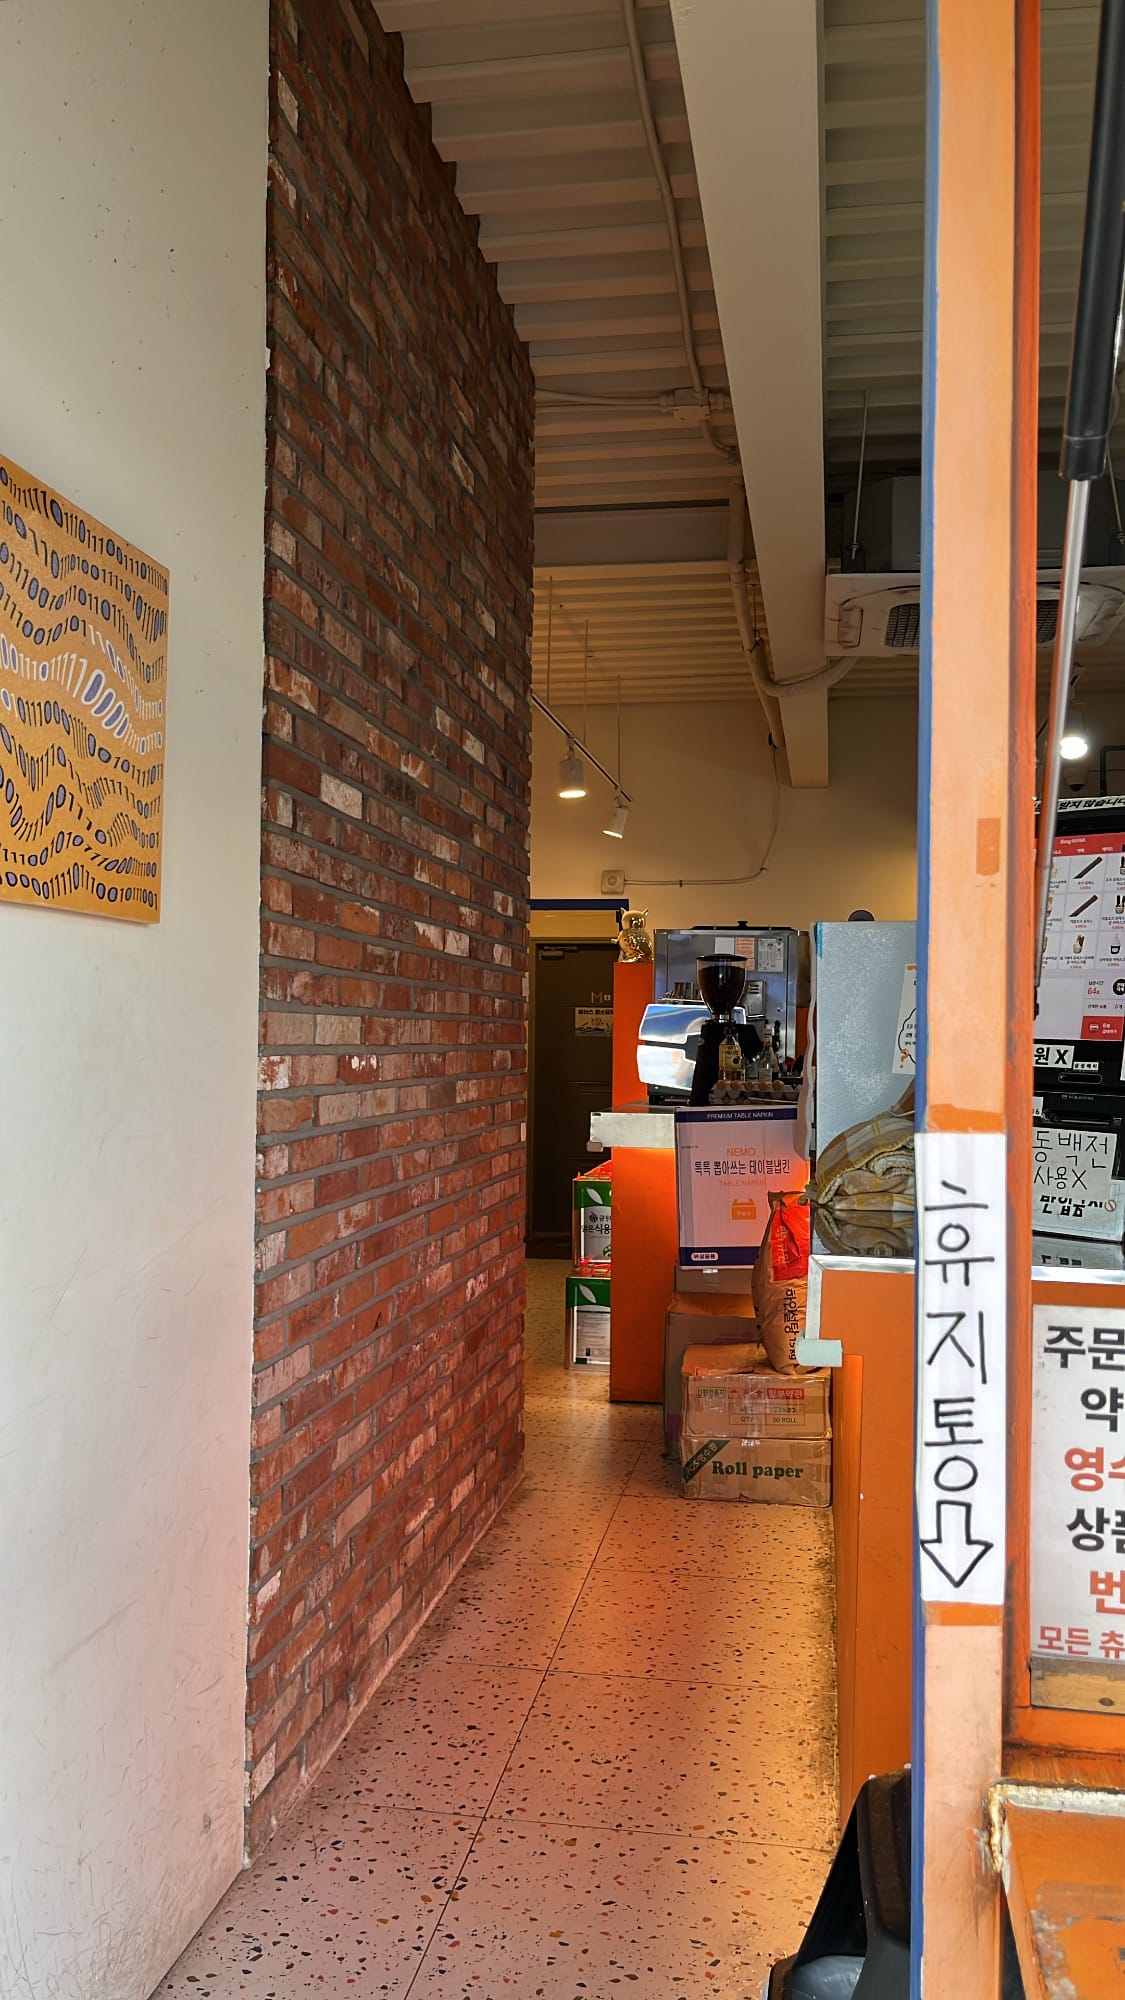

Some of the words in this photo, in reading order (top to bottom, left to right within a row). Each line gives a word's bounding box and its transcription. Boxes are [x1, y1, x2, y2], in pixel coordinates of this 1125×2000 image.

[1054, 1049, 1069, 1065] X
[726, 1147, 756, 1157] NEMO
[1033, 1131, 1108, 1168] 동백전
[695, 1161, 711, 1176] 톡톡
[714, 1160, 747, 1176] 뽑아쓰는
[749, 1159, 790, 1175] 테이블냅킨
[720, 1179, 740, 1187] TABLE
[924, 1180, 996, 1493] 휴지통
[1043, 1325, 1125, 1372] 주문
[1080, 1387, 1124, 1433] 약
[712, 1460, 747, 1475] Roll
[752, 1464, 804, 1480] paper
[1037, 1626, 1092, 1656] 모든
